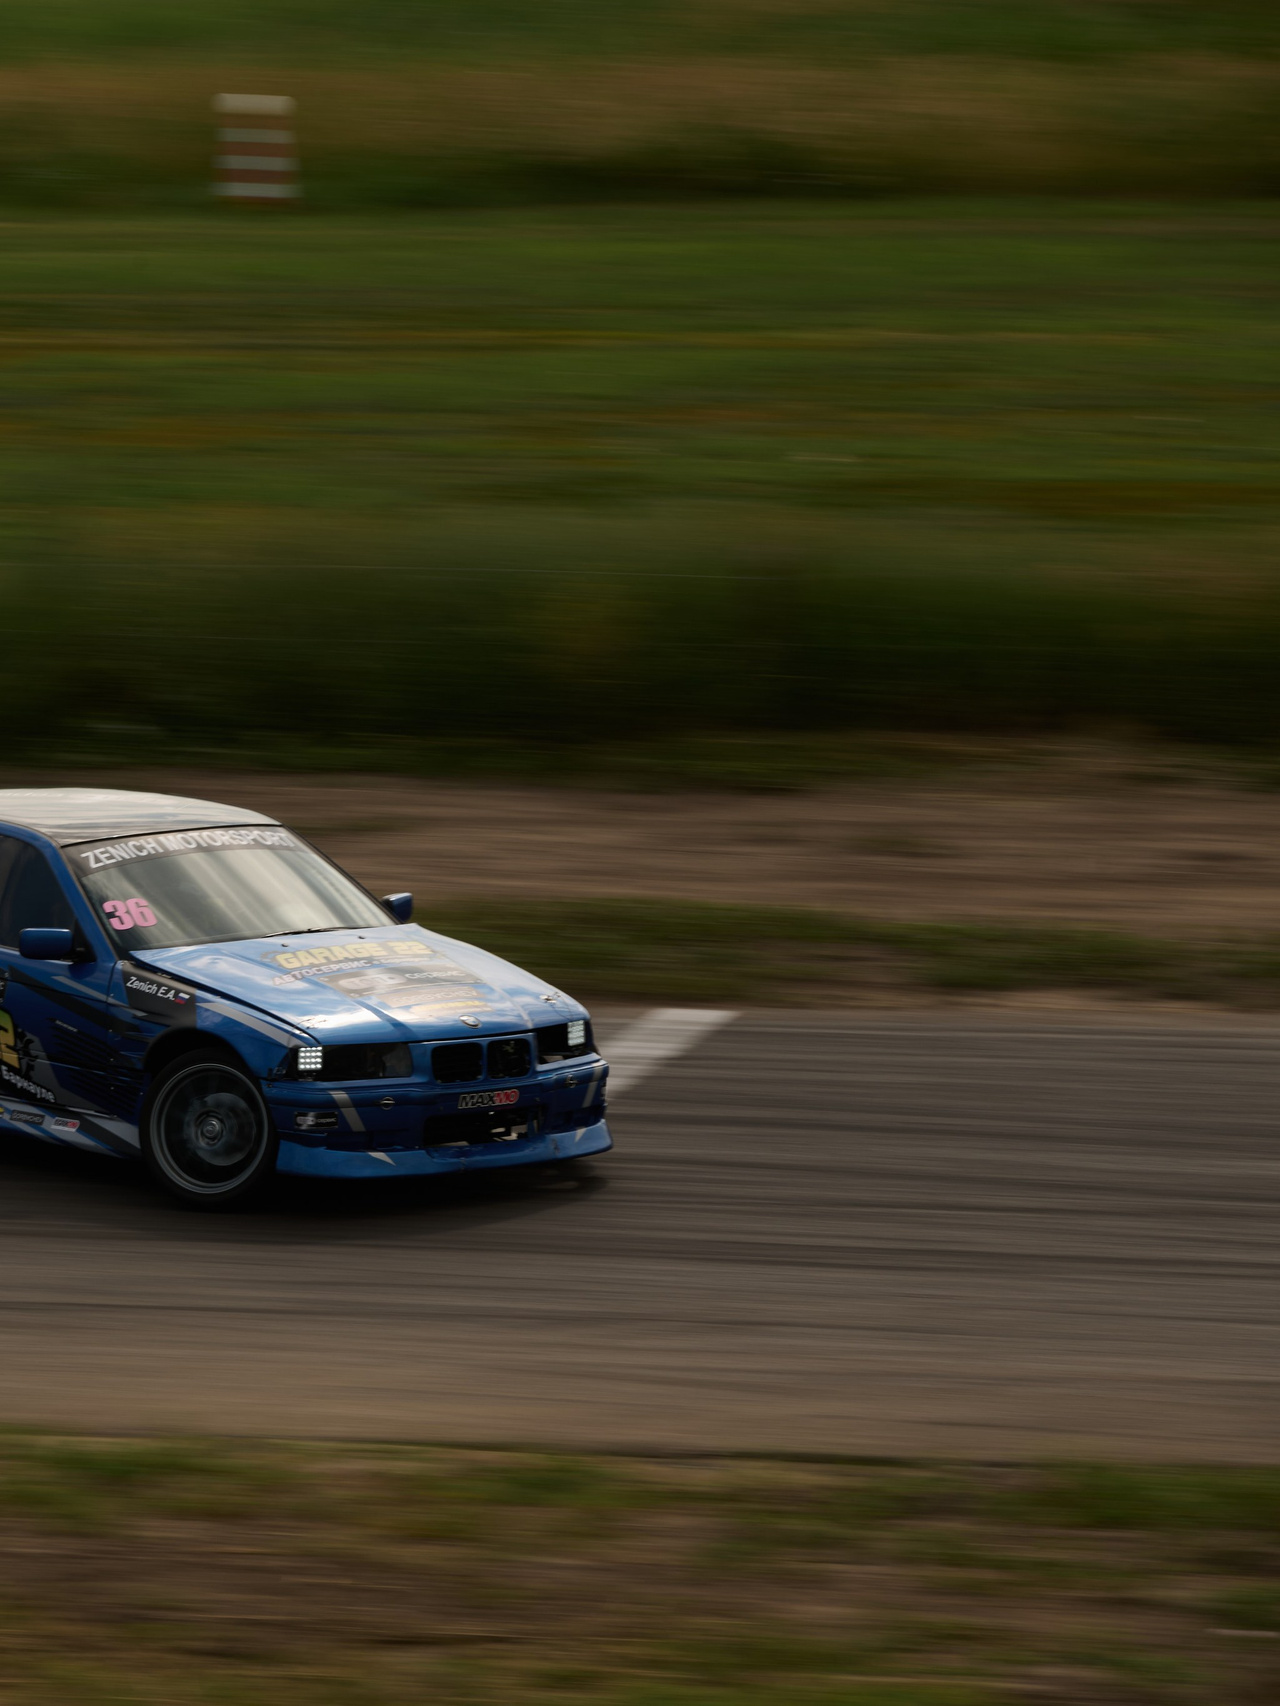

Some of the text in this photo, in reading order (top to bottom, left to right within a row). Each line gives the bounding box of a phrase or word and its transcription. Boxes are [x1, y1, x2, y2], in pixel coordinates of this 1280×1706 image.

[80, 829, 297, 869] ZENICH MOTORSPORT
[102, 897, 158, 931] 36
[275, 942, 390, 969] GARAGE
[387, 940, 433, 955] 22
[125, 976, 158, 995] Zenich
[272, 959, 372, 986] АВТОСЕРВИС
